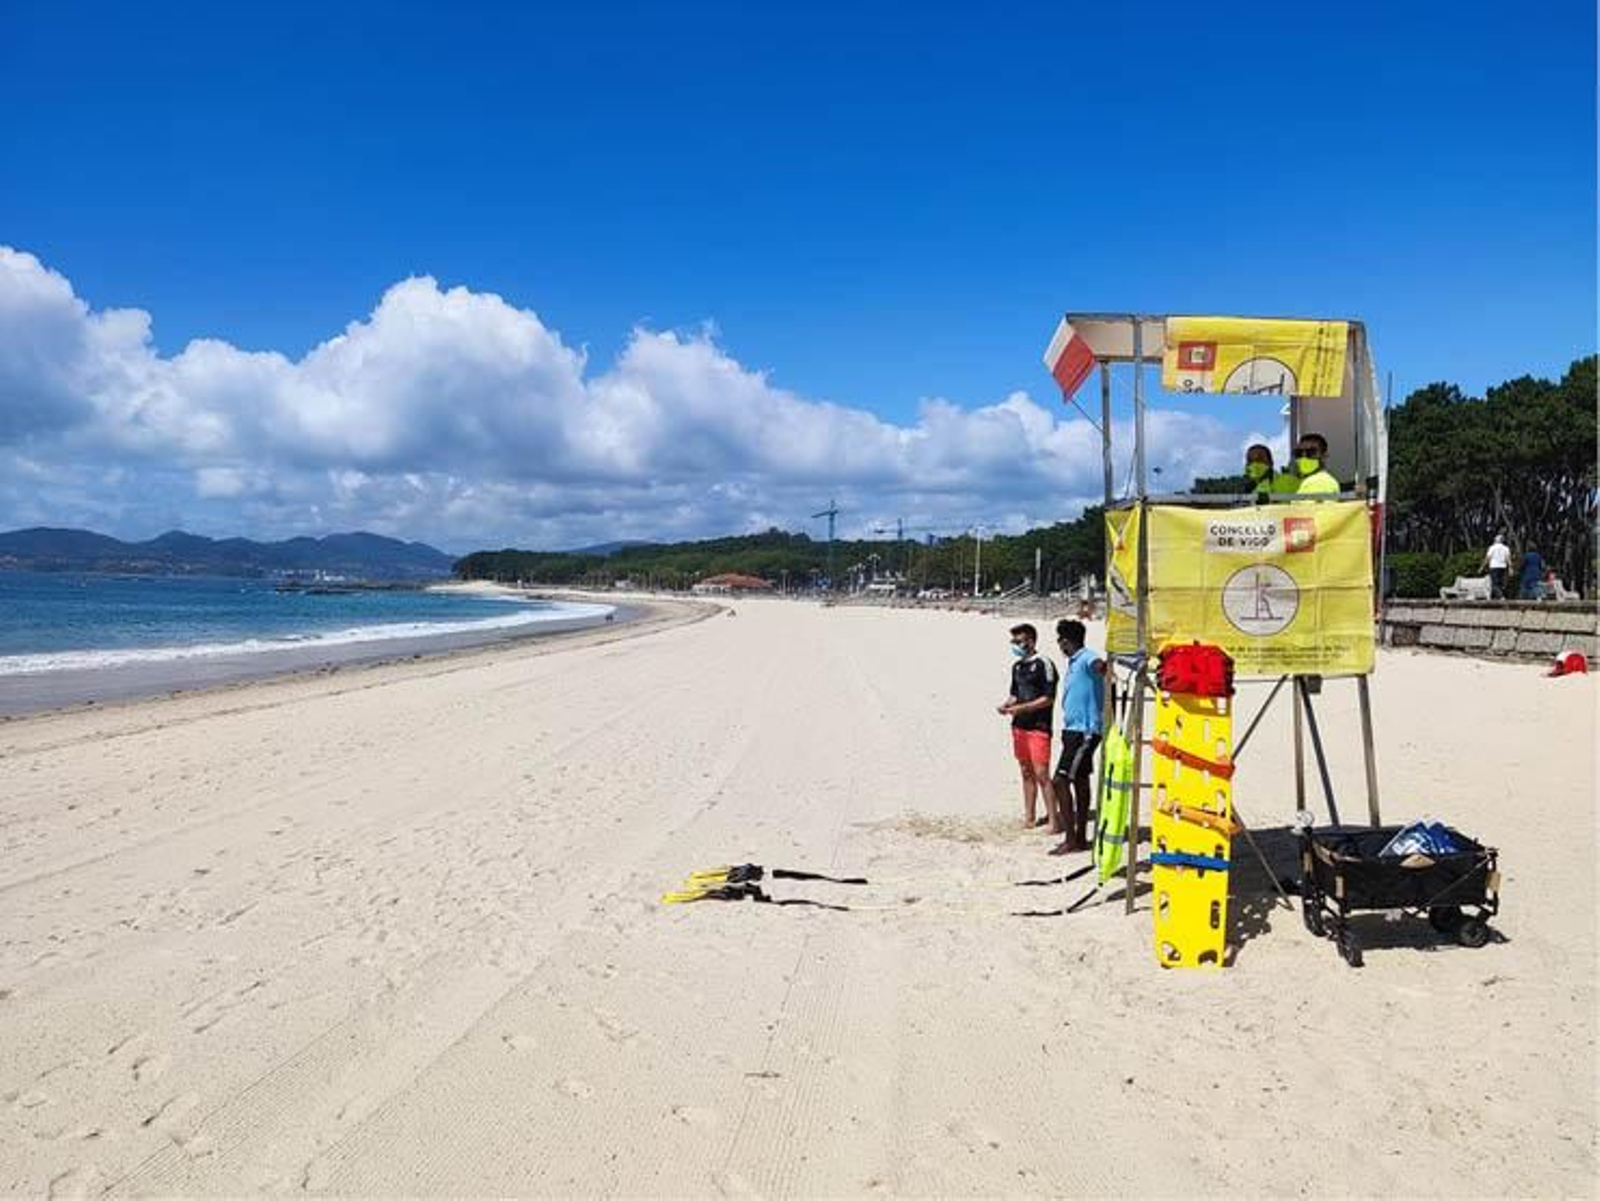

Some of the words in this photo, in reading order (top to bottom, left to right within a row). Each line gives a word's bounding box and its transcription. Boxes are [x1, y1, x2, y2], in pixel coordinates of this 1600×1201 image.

[1210, 524, 1276, 536] CONCELLO
[1218, 537, 1234, 547] DE
[1240, 537, 1270, 547] VIGO
